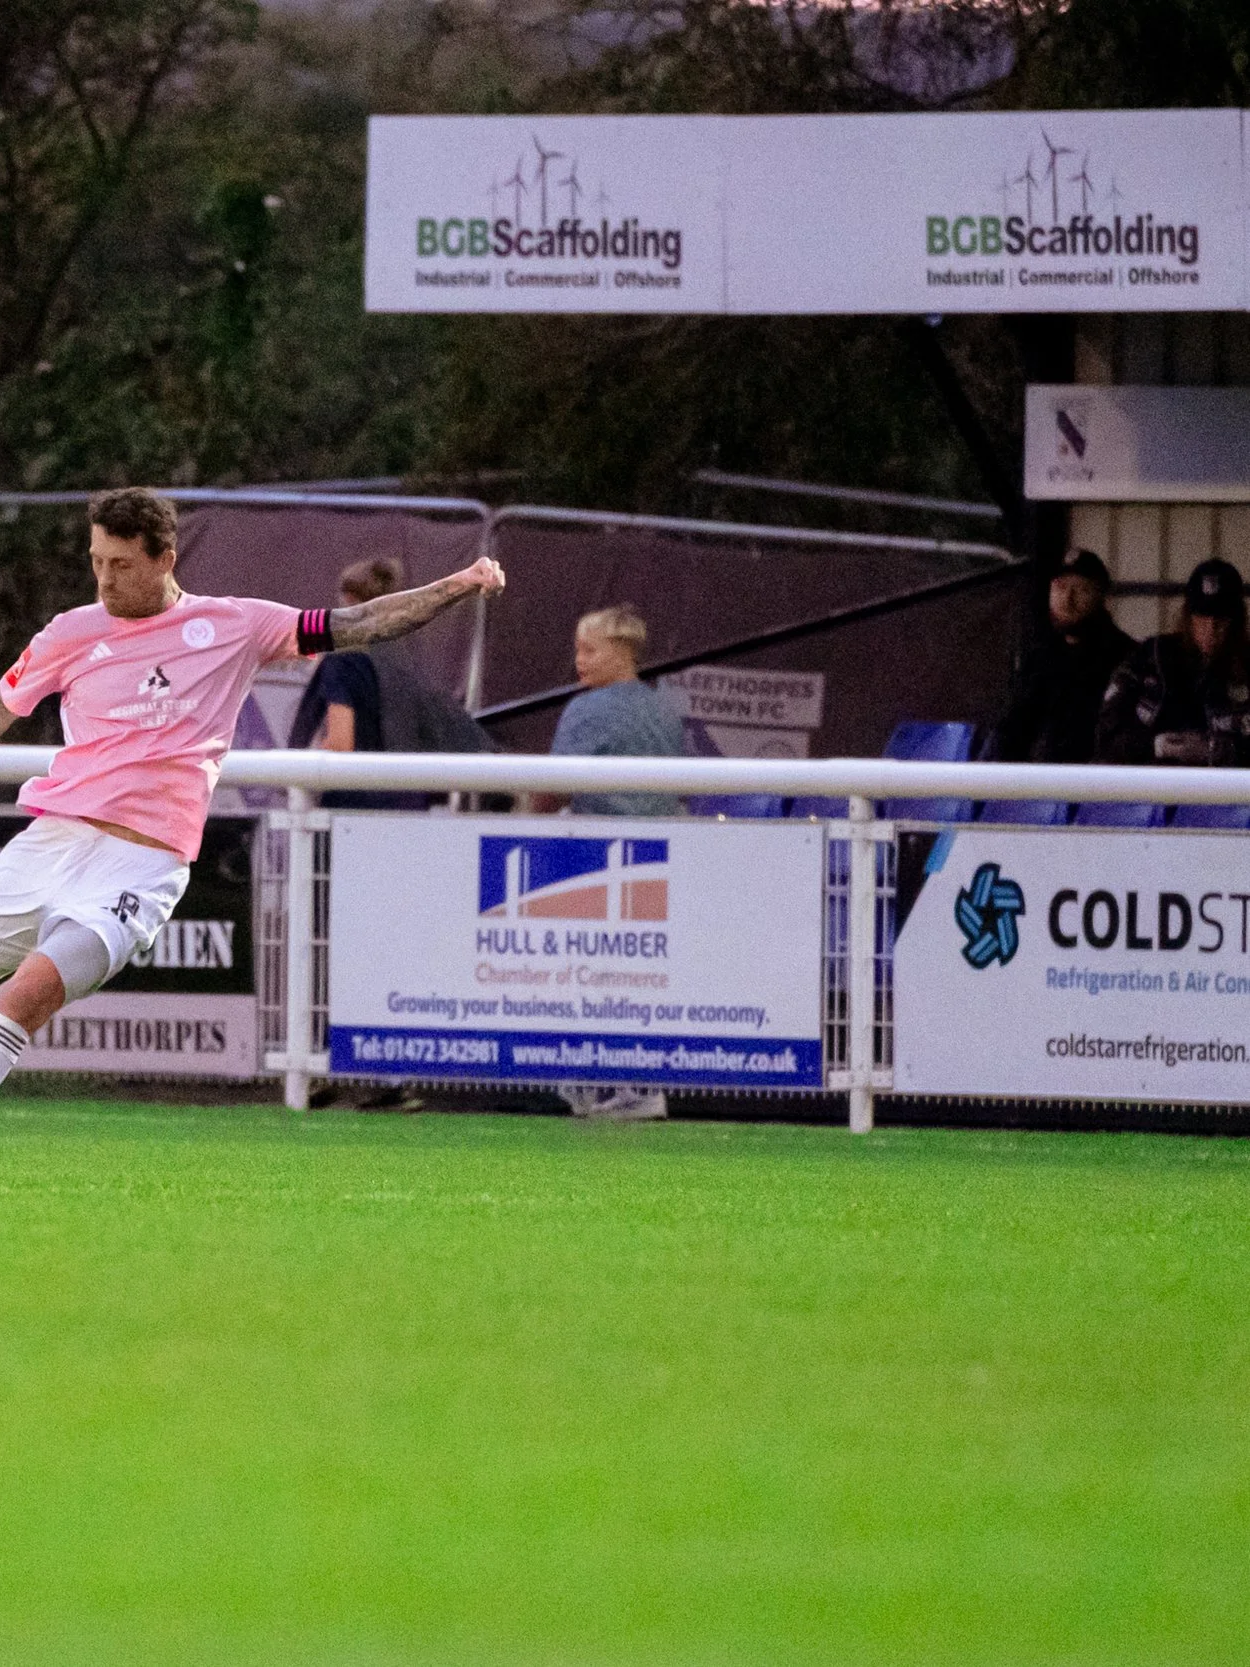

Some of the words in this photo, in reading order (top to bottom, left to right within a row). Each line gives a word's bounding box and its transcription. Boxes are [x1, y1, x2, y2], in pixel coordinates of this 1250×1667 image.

[416, 270, 491, 287] Industrial
[504, 270, 599, 288] Commercial
[614, 271, 682, 288] Offshore
[926, 268, 1004, 286] Industrial
[1018, 268, 1113, 286] Commercial
[1128, 268, 1199, 286] Offshore
[476, 928, 536, 955] HULL
[543, 930, 558, 956] &
[566, 930, 668, 958] HUMBER
[475, 962, 550, 985] Chamber
[555, 964, 572, 985] of
[576, 965, 669, 989] Commerce
[1046, 967, 1163, 996] Refrigeration
[1168, 971, 1179, 992] &
[1185, 971, 1210, 992] Air
[1214, 971, 1250, 994] Con
[388, 991, 457, 1020] Growing
[461, 999, 498, 1020] your
[582, 997, 651, 1026] building
[655, 1004, 683, 1020] our
[687, 1004, 770, 1030] economy.
[31, 1014, 226, 1052] LEETHORPES
